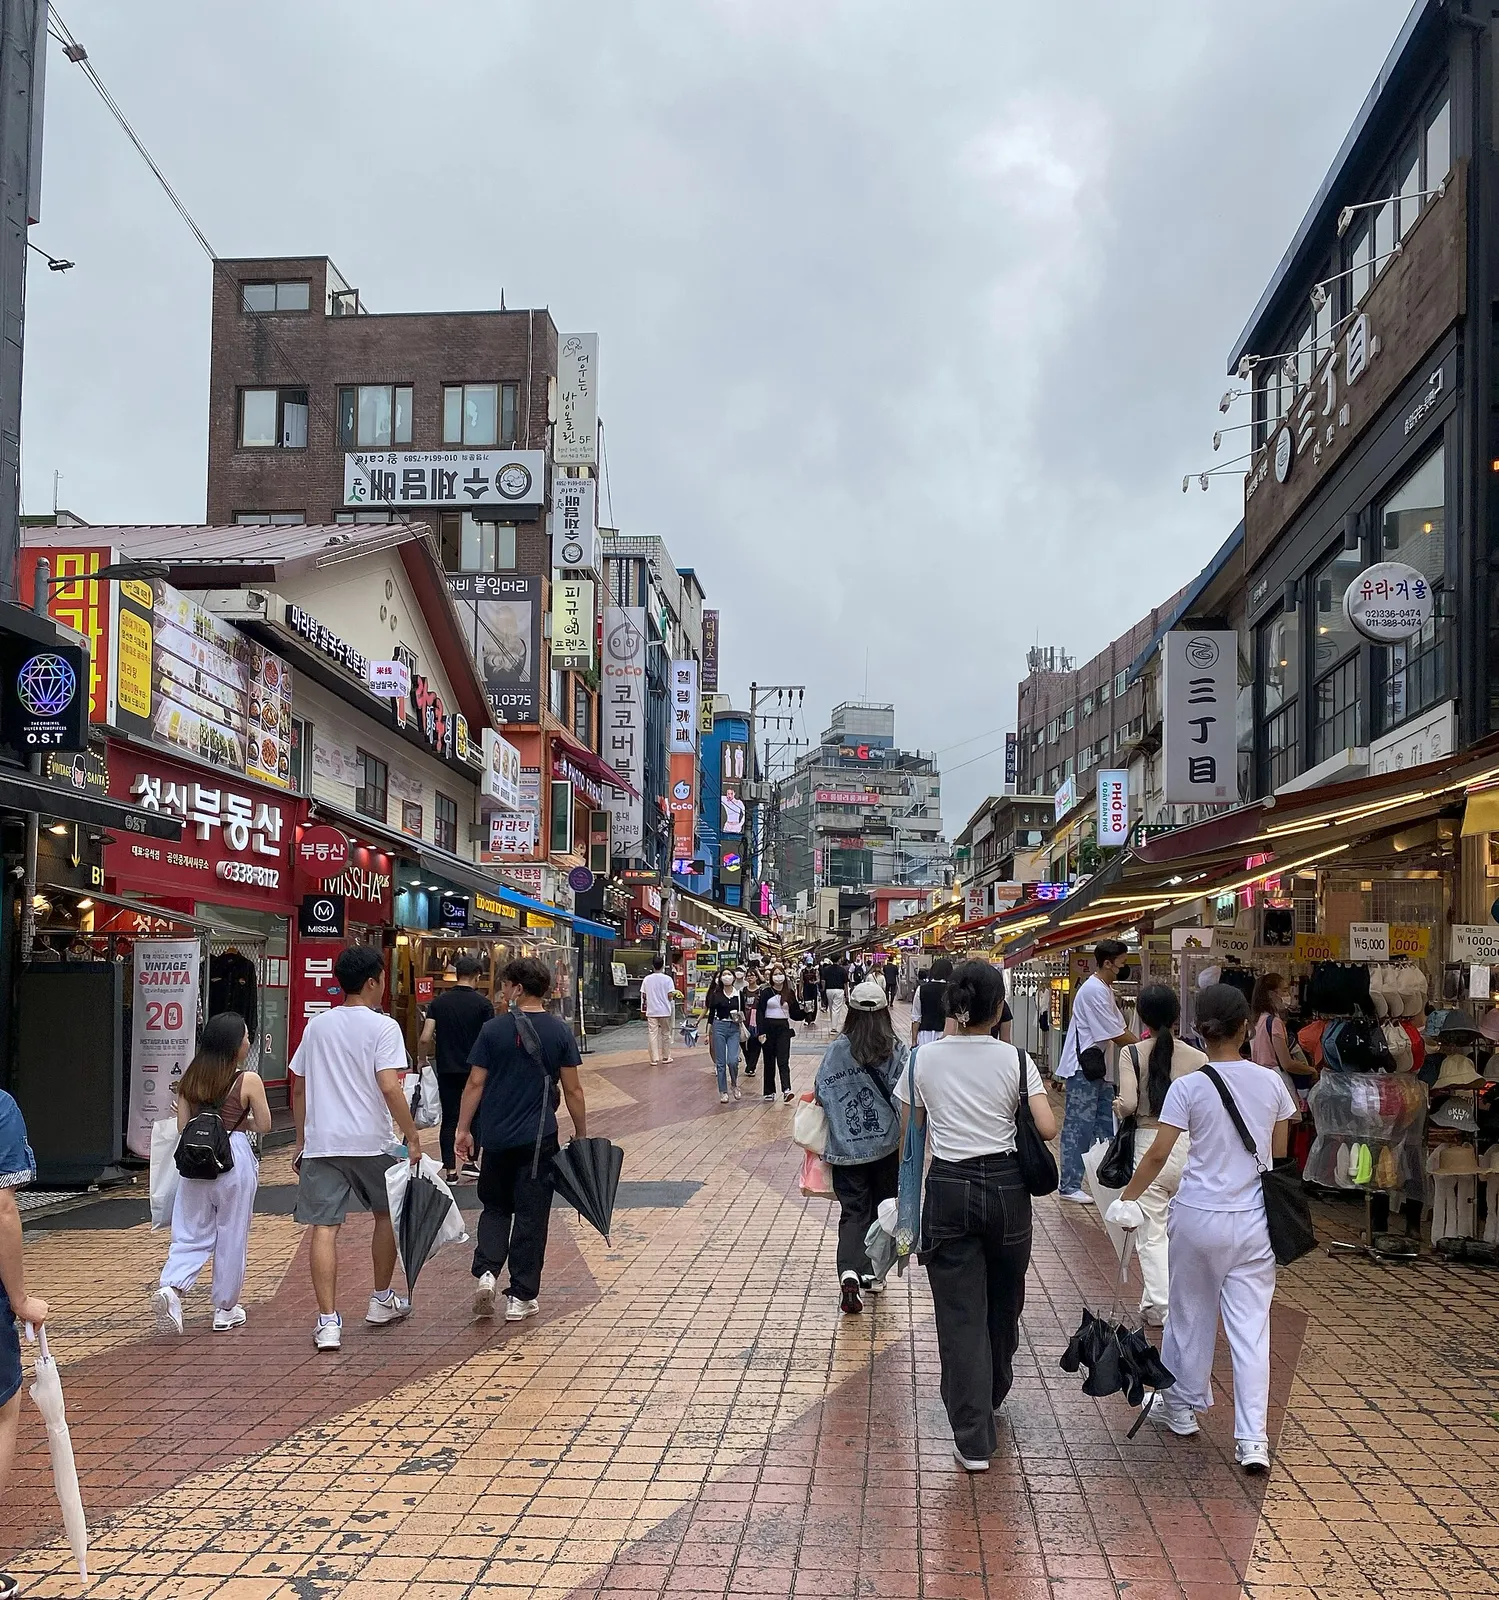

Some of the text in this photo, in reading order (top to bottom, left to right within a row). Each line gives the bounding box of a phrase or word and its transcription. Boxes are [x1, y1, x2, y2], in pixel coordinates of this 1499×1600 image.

[579, 436, 591, 444] 5F
[370, 467, 490, 501] 수제담배
[563, 496, 580, 540] 수제담배
[474, 575, 528, 595] 붙임머리
[1365, 609, 1421, 618] 02)336-0474
[1366, 619, 1422, 627] 011-388-0474
[554, 639, 588, 651] 프렌즈
[705, 621, 715, 660] 더하우스
[564, 657, 578, 667] B1
[517, 711, 530, 720] 3F
[702, 702, 713, 729] 사진
[1187, 677, 1217, 785] 三丁目
[26, 733, 63, 744] O.S.T
[86, 771, 106, 787] SANTA
[492, 820, 530, 832] 마라탕
[301, 843, 345, 861] 부동산
[491, 840, 529, 852] 쌀국수
[614, 841, 632, 854] 2F
[91, 865, 104, 885] B1
[232, 861, 279, 889] 338-8112
[514, 869, 541, 880] 전문점
[307, 925, 338, 933] MISSHA
[1299, 947, 1330, 959] 1,000
[1476, 947, 1499, 957] 300
[144, 962, 187, 971] VINTAGE
[139, 971, 191, 986] SANTA
[418, 982, 431, 994] SALE
[145, 1001, 183, 1031] 20
[824, 1070, 847, 1086] DENIM
